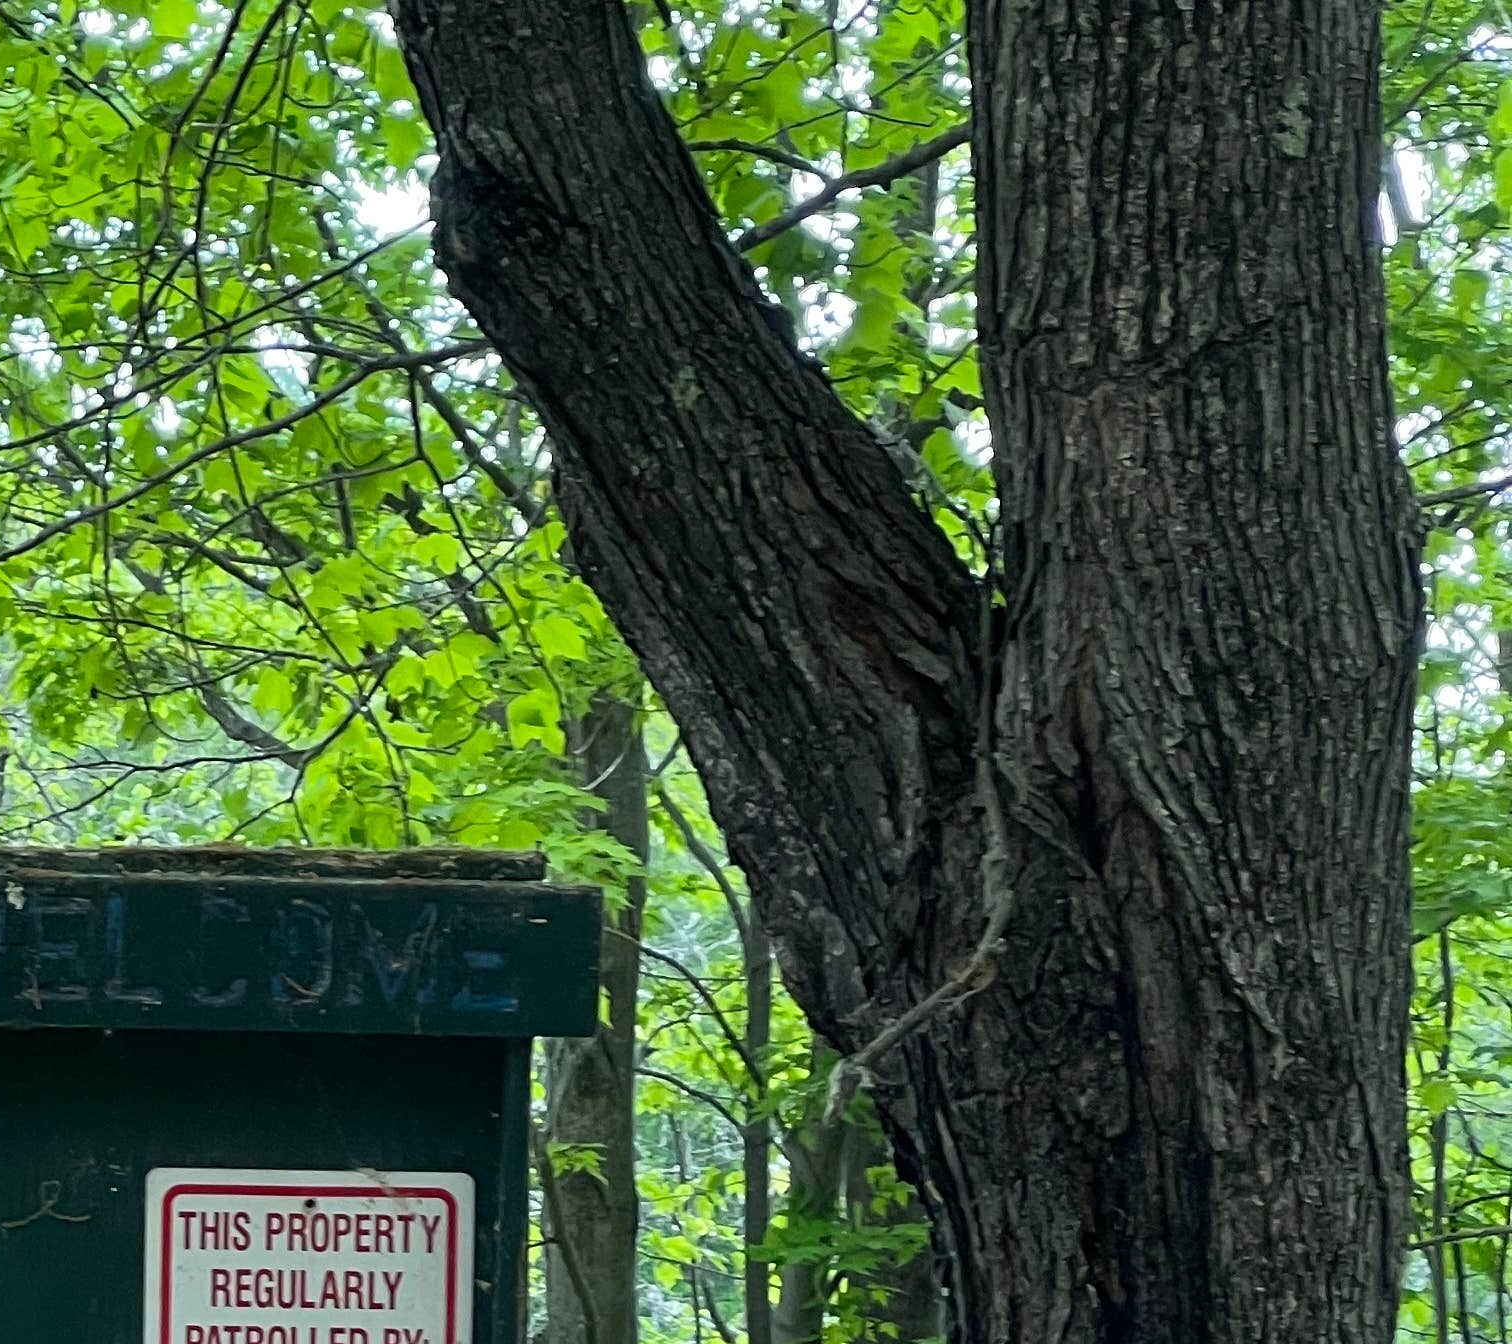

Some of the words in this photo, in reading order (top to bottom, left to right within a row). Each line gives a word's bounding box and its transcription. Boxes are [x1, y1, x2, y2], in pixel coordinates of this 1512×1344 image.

[178, 1211, 252, 1251] THIS
[265, 1212, 441, 1254] PROPERTY
[210, 1268, 403, 1310] REGULARLY
